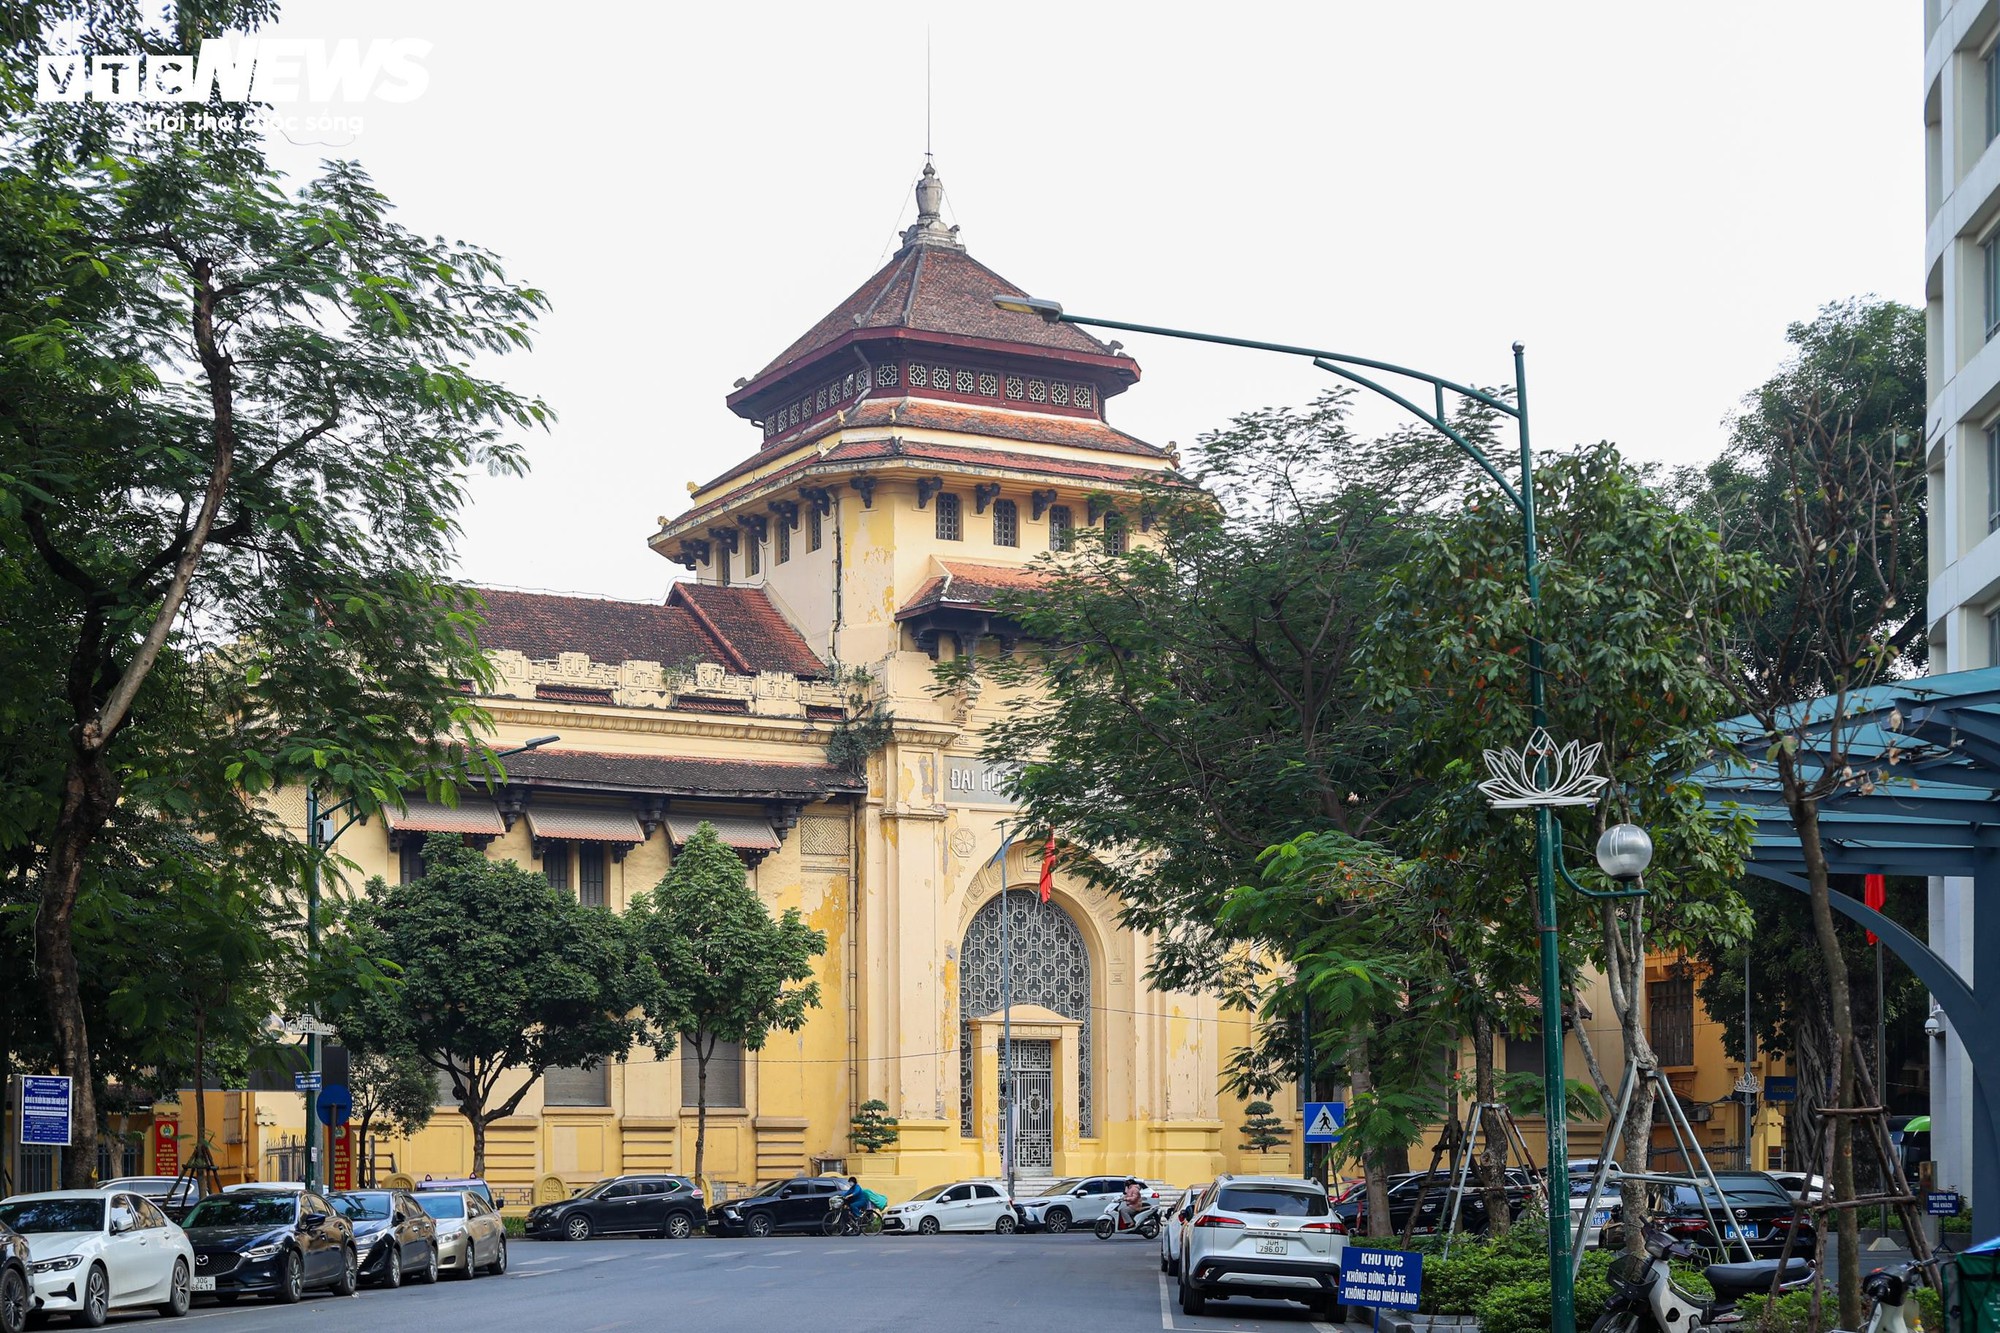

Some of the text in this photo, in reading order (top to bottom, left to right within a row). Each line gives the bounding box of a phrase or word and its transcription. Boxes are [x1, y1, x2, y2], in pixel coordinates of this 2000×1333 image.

[950, 768, 1006, 795] ĐẠI HỌ
[1361, 1253, 1404, 1270] KHU VỰC
[1346, 1269, 1367, 1284] KHÔNG
[1397, 1274, 1406, 1287] XE
[1344, 1285, 1366, 1300] KHÔNG
[1366, 1289, 1381, 1302] GIAO
[1381, 1288, 1400, 1305] NHẬN
[1400, 1290, 1418, 1305] HÀNG
